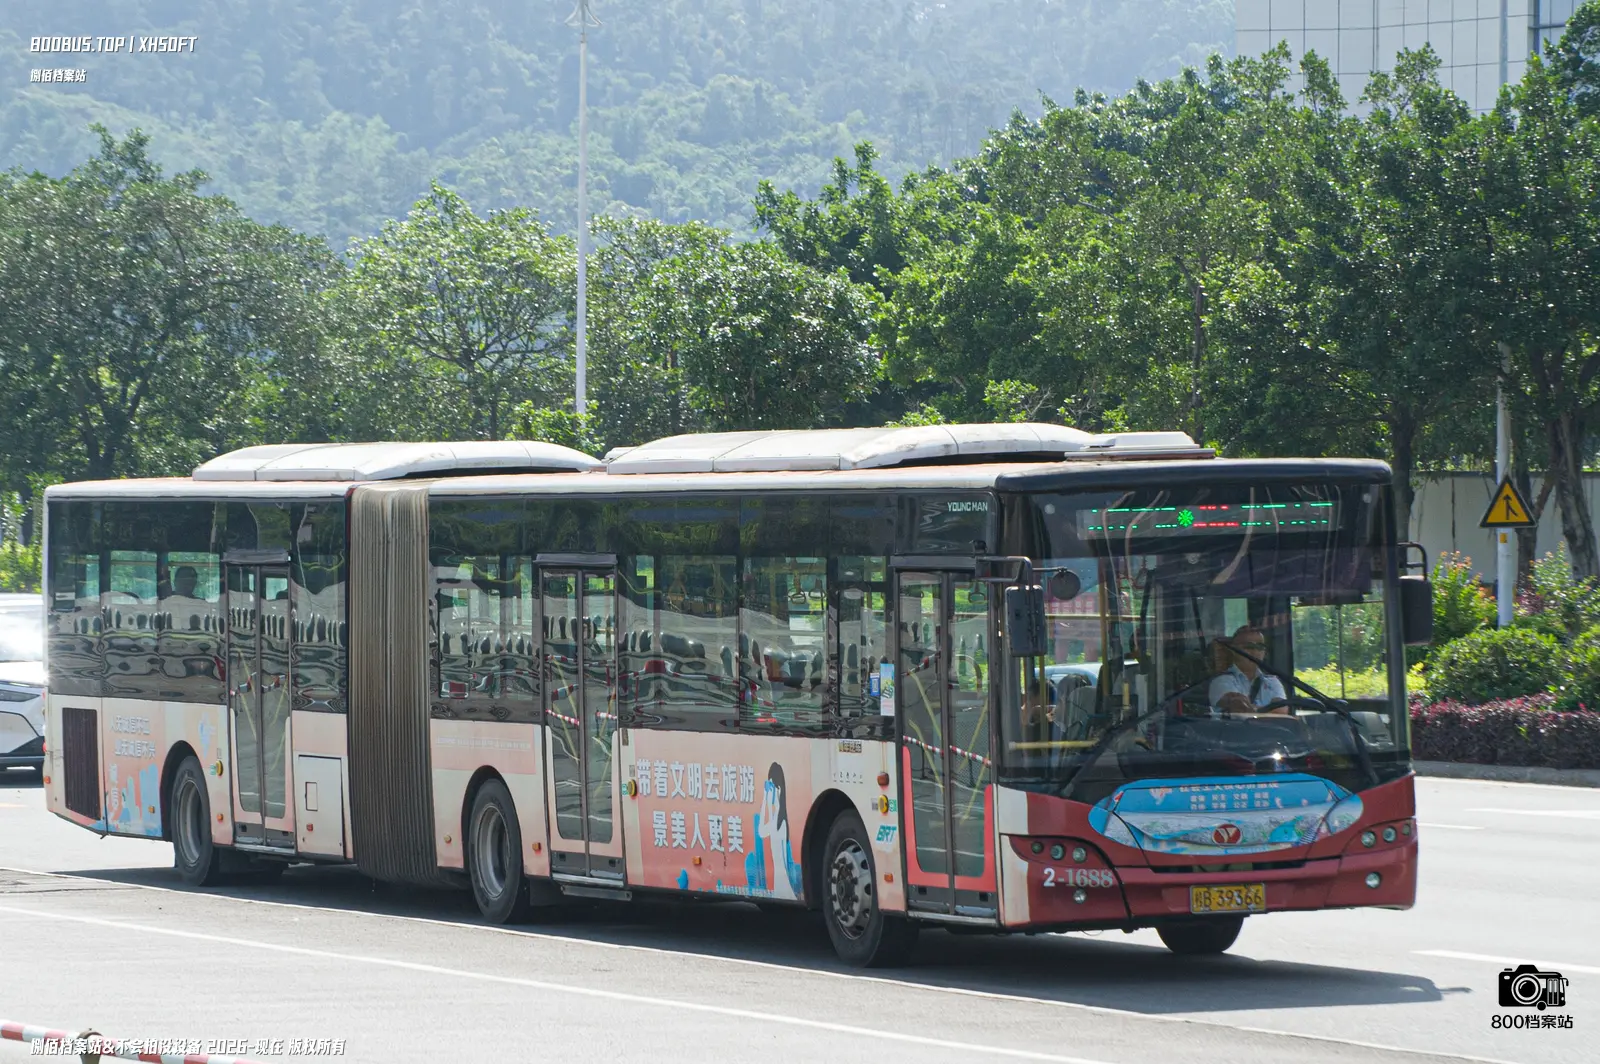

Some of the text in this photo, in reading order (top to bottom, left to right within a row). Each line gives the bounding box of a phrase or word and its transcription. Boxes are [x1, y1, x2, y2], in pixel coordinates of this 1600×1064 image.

[636, 758, 755, 803] 带着文明去旅游
[653, 810, 744, 854] 景美人更美
[876, 824, 897, 843] BRT
[1043, 867, 1113, 888] 2-1688
